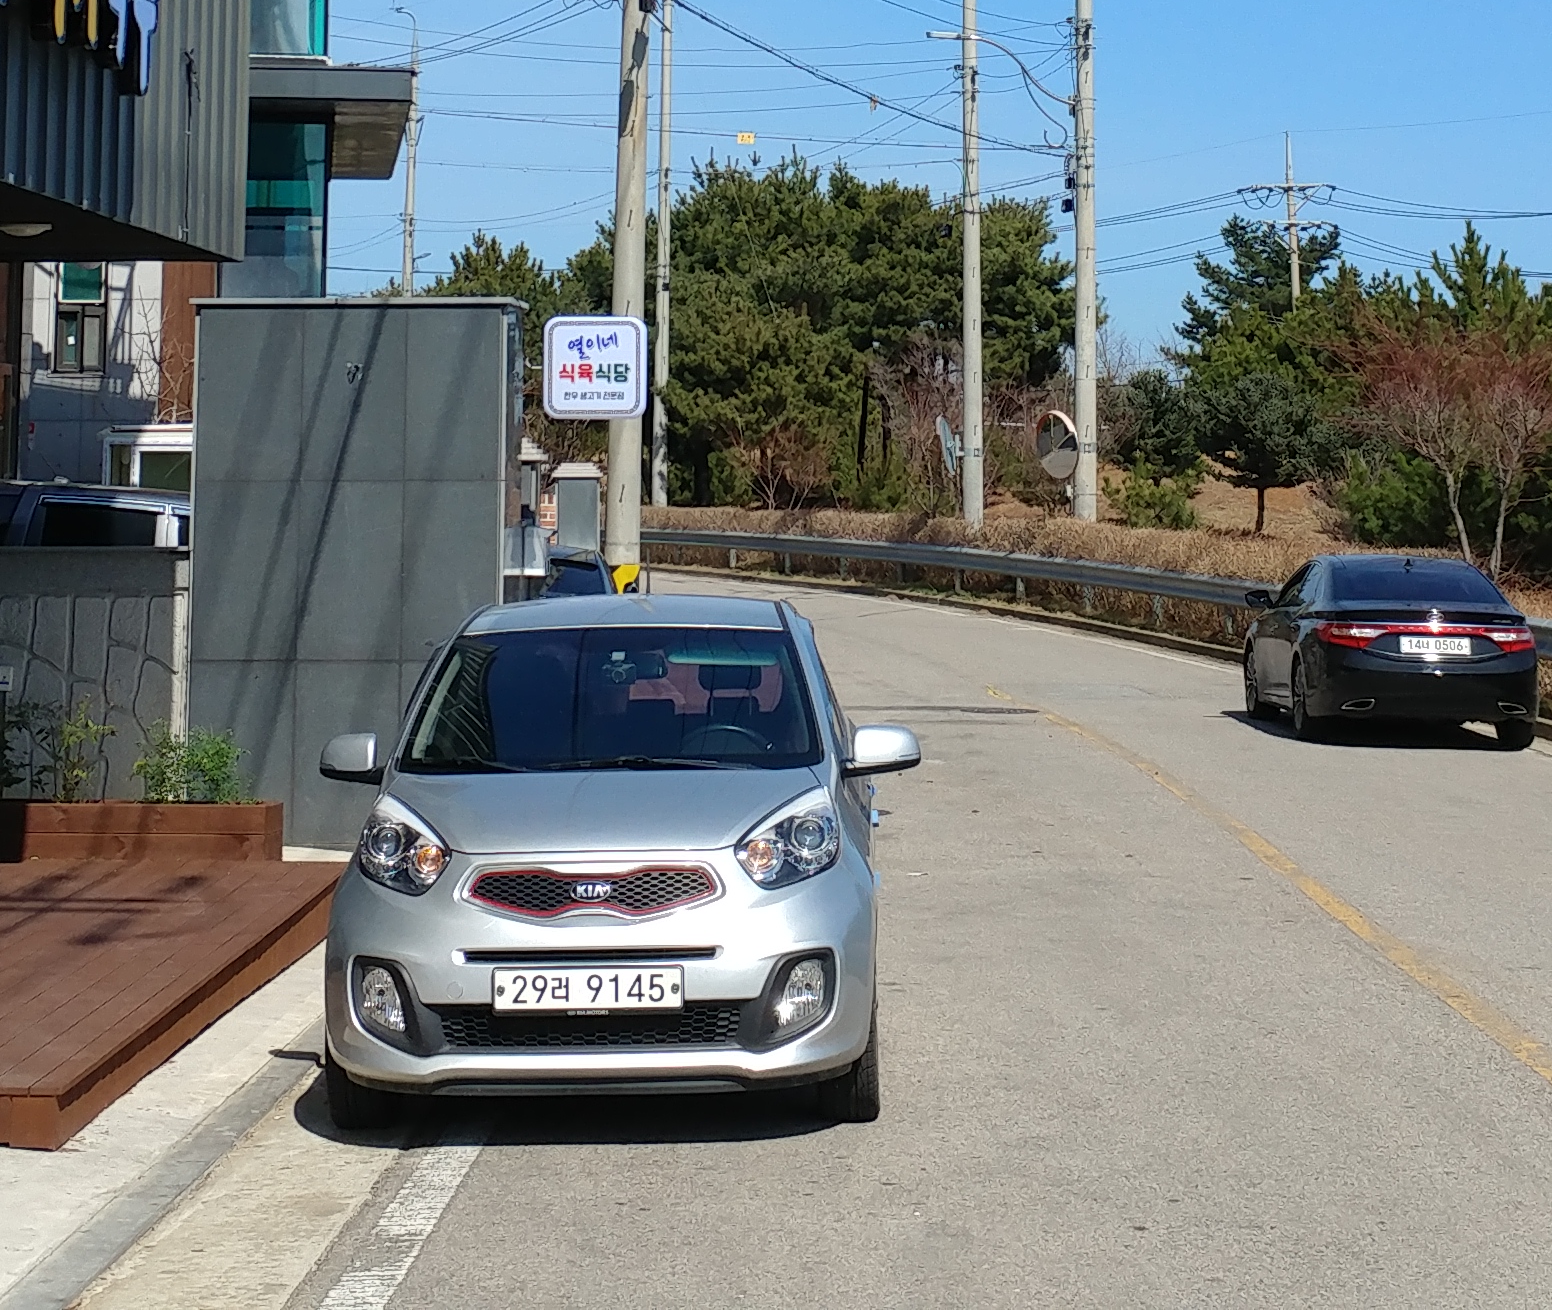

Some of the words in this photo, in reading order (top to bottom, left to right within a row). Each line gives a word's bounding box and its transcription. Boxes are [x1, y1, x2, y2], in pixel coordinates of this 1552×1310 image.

[567, 331, 619, 360] 열이네
[559, 363, 631, 384] 식육식당
[1434, 640, 1464, 651] 0506
[576, 884, 609, 898] KIA
[512, 974, 570, 1004] 29러
[586, 974, 665, 1003] 9145
